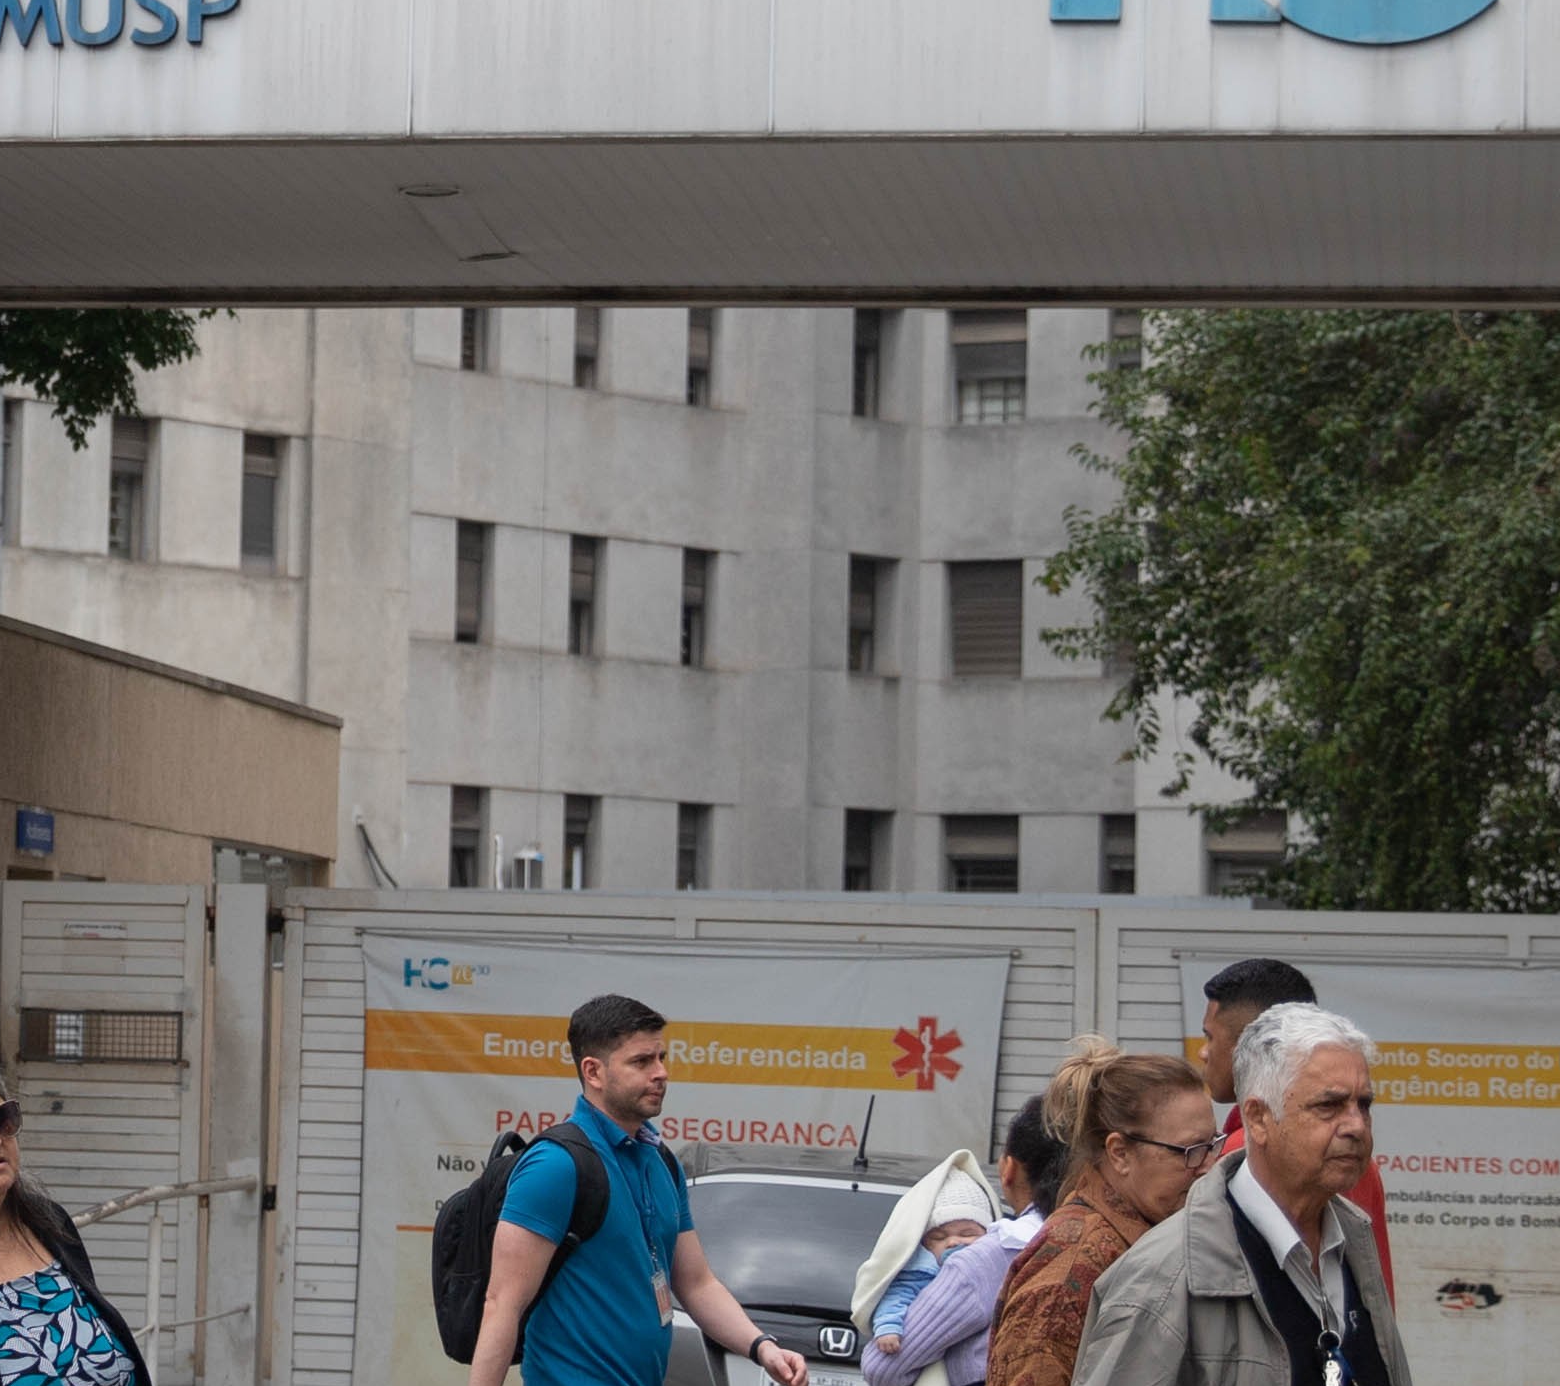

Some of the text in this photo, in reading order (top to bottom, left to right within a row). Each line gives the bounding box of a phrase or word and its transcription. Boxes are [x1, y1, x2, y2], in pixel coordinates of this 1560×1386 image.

[403, 957, 450, 991] HC
[483, 1032, 867, 1071] Emerg Referenciada
[1369, 1049, 1419, 1067] onto
[1426, 1048, 1519, 1069] Socorro
[1524, 1051, 1554, 1071] do
[1374, 1074, 1481, 1101] rgência
[437, 1154, 476, 1172] Não
[1375, 1154, 1503, 1176] PACIENTES
[1509, 1158, 1560, 1177] COM
[1386, 1191, 1475, 1205] mbulâncias
[1414, 1212, 1435, 1227] do
[1440, 1213, 1488, 1229] Corpo
[1495, 1215, 1515, 1228] de
